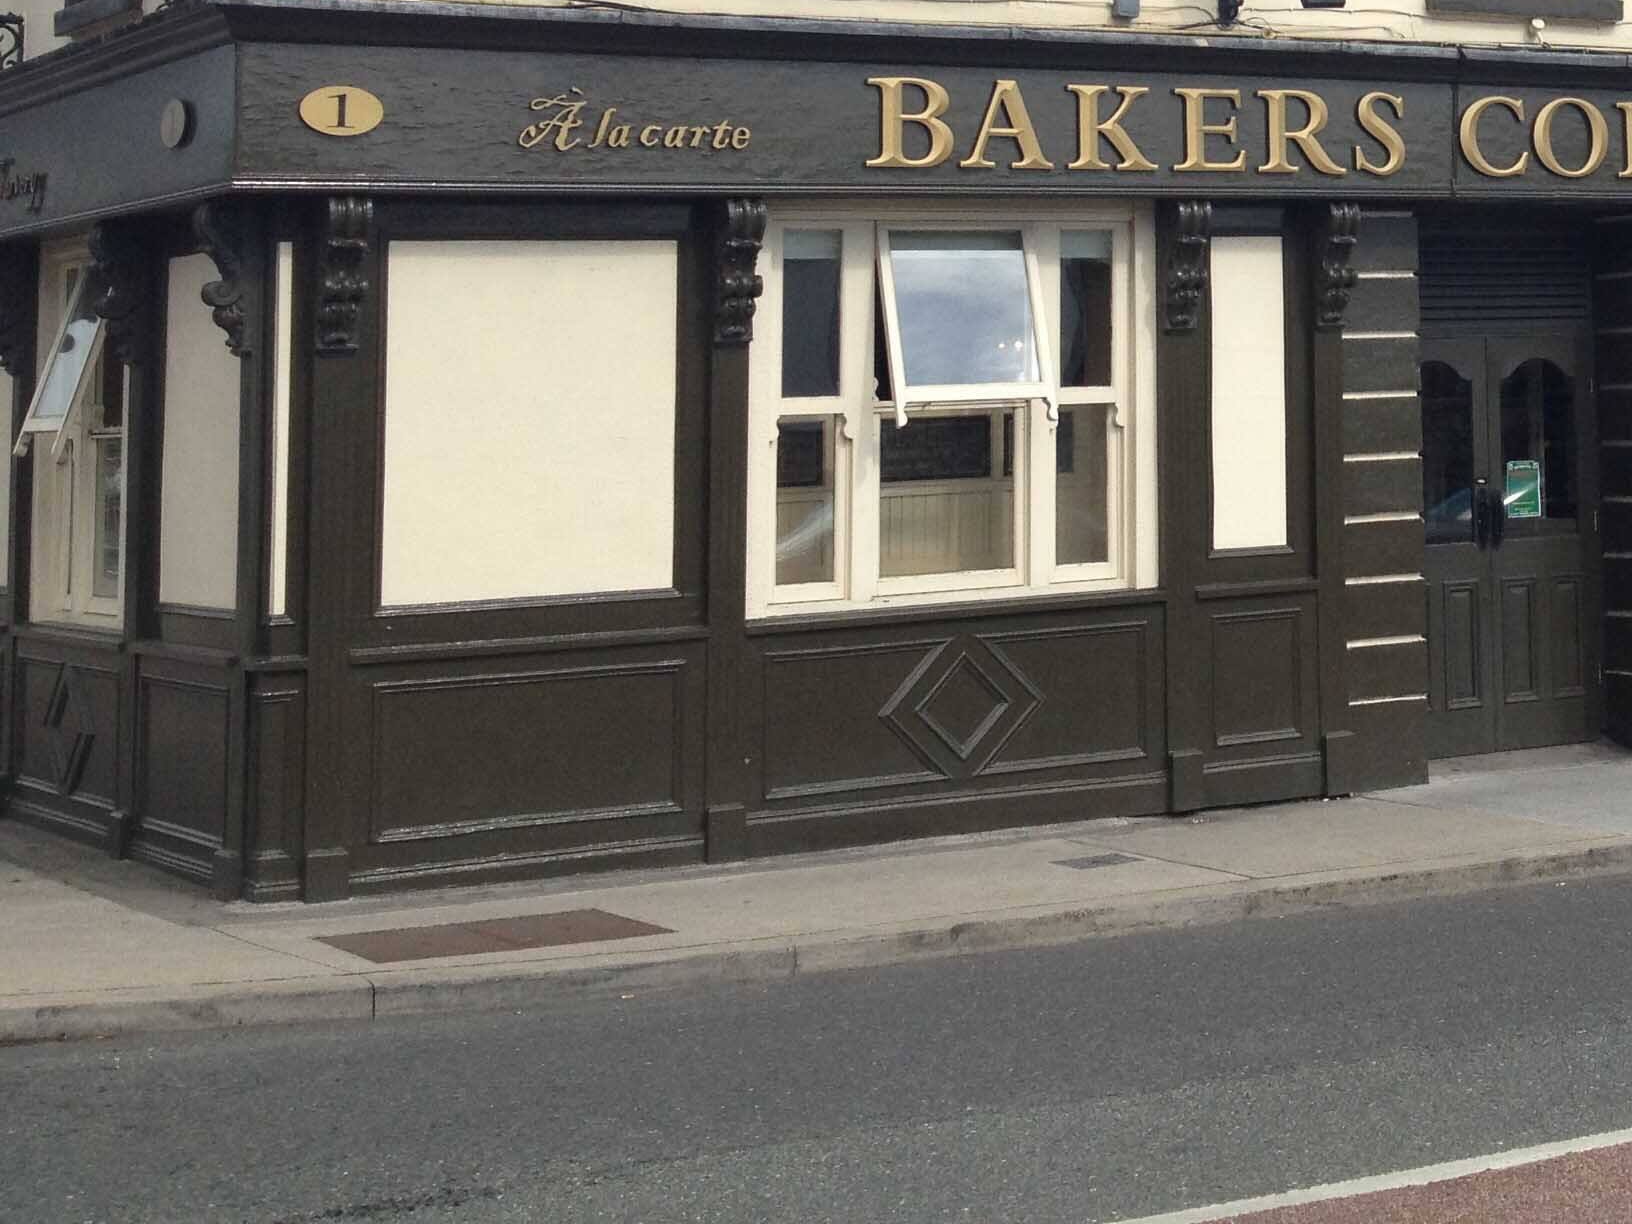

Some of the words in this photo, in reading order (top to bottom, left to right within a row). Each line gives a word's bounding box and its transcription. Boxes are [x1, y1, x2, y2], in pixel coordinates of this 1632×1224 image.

[327, 93, 355, 129] 1
[587, 108, 630, 149] la
[639, 120, 751, 150] carte
[865, 76, 1407, 176] BAKERS
